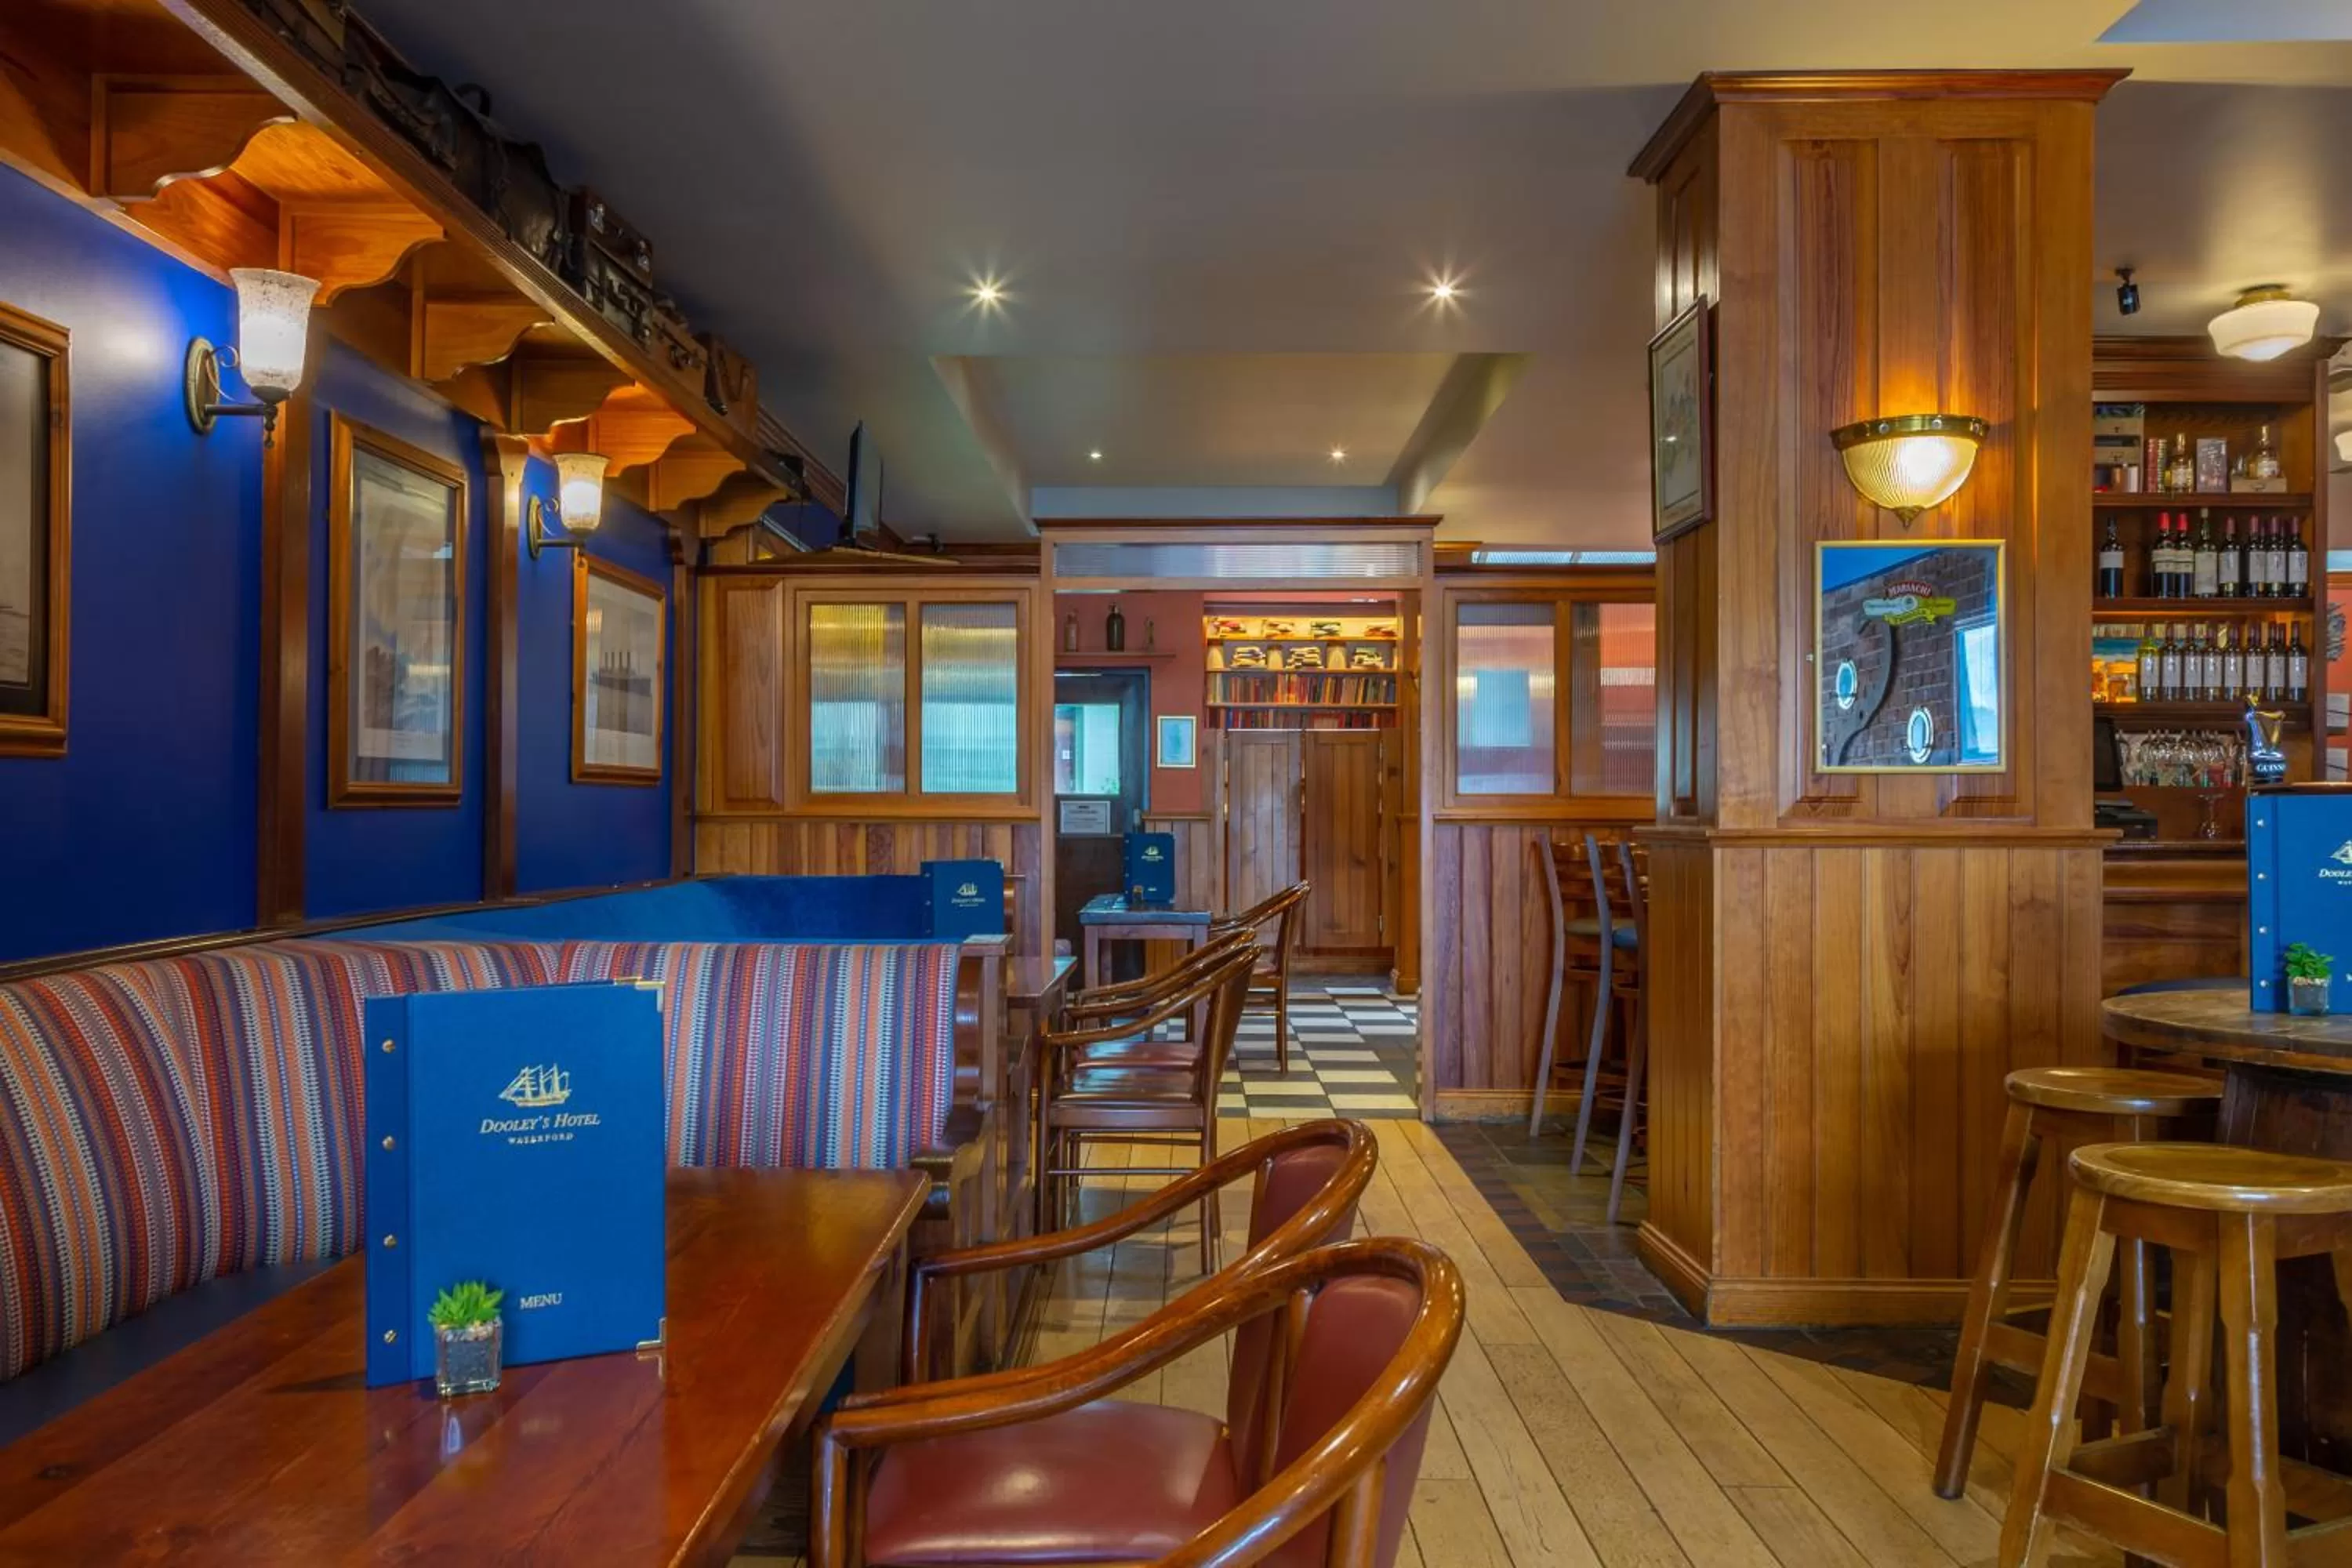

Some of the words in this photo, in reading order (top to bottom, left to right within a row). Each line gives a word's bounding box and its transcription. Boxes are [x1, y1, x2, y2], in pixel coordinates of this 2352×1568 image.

[479, 1115, 550, 1134] DOOLEY'S
[553, 1112, 601, 1128] HOTEL
[507, 1132, 575, 1144] WATERFORD
[520, 1292, 563, 1310] MENU
